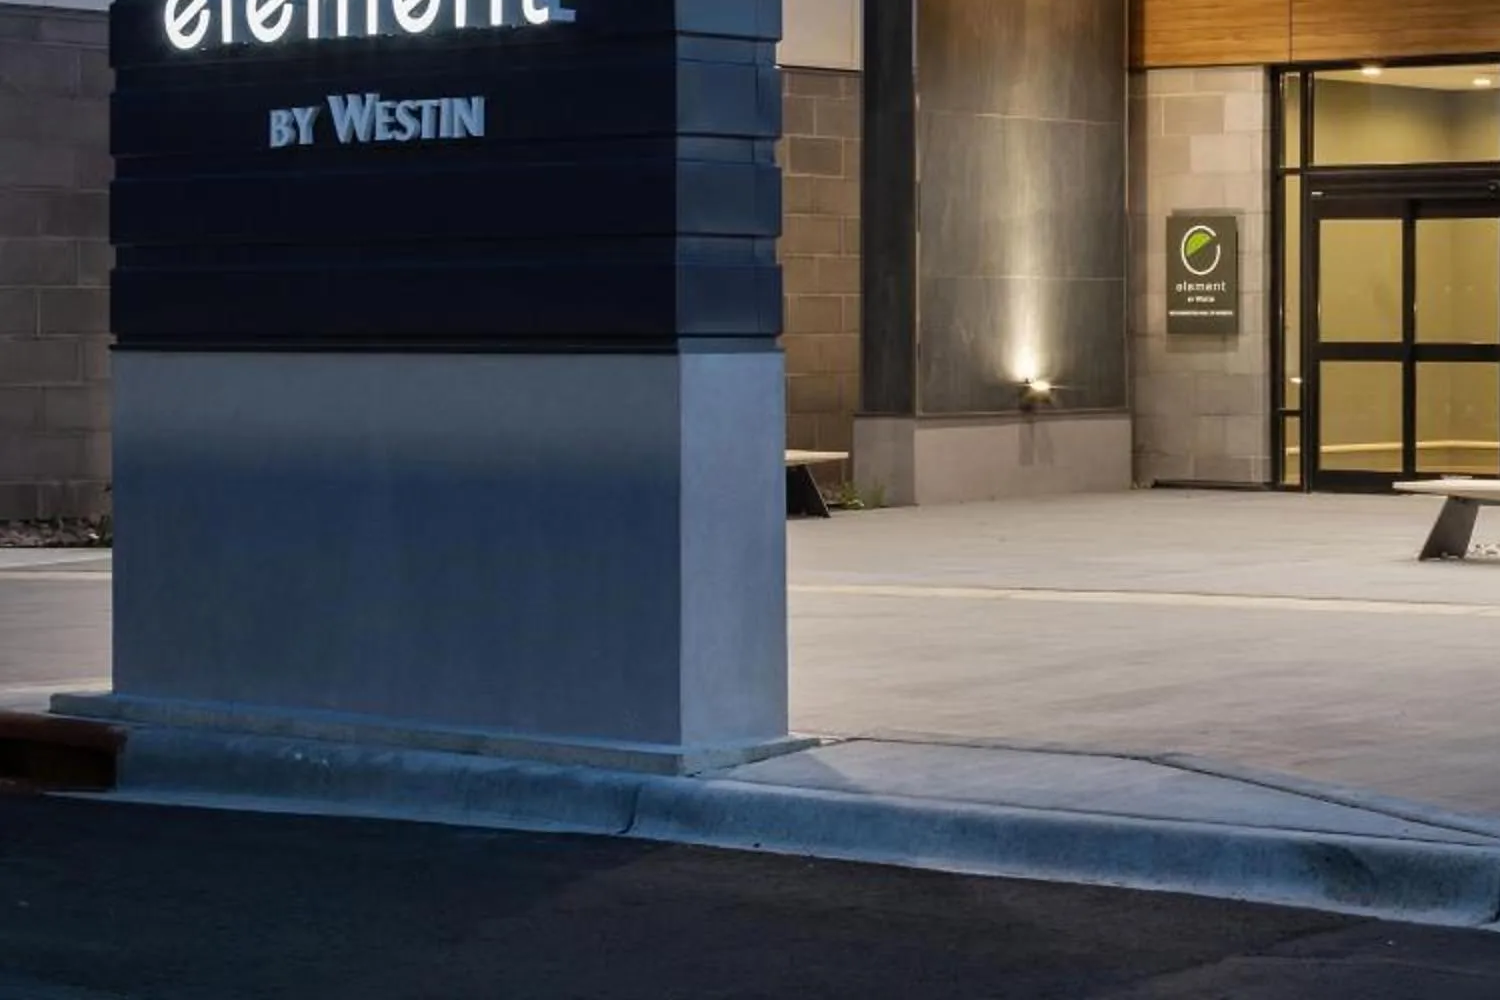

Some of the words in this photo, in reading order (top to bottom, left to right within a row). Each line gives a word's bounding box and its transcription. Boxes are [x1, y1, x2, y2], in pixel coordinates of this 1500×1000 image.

[270, 106, 320, 148] BY
[327, 93, 485, 144] WESTIN
[1175, 280, 1226, 292] element
